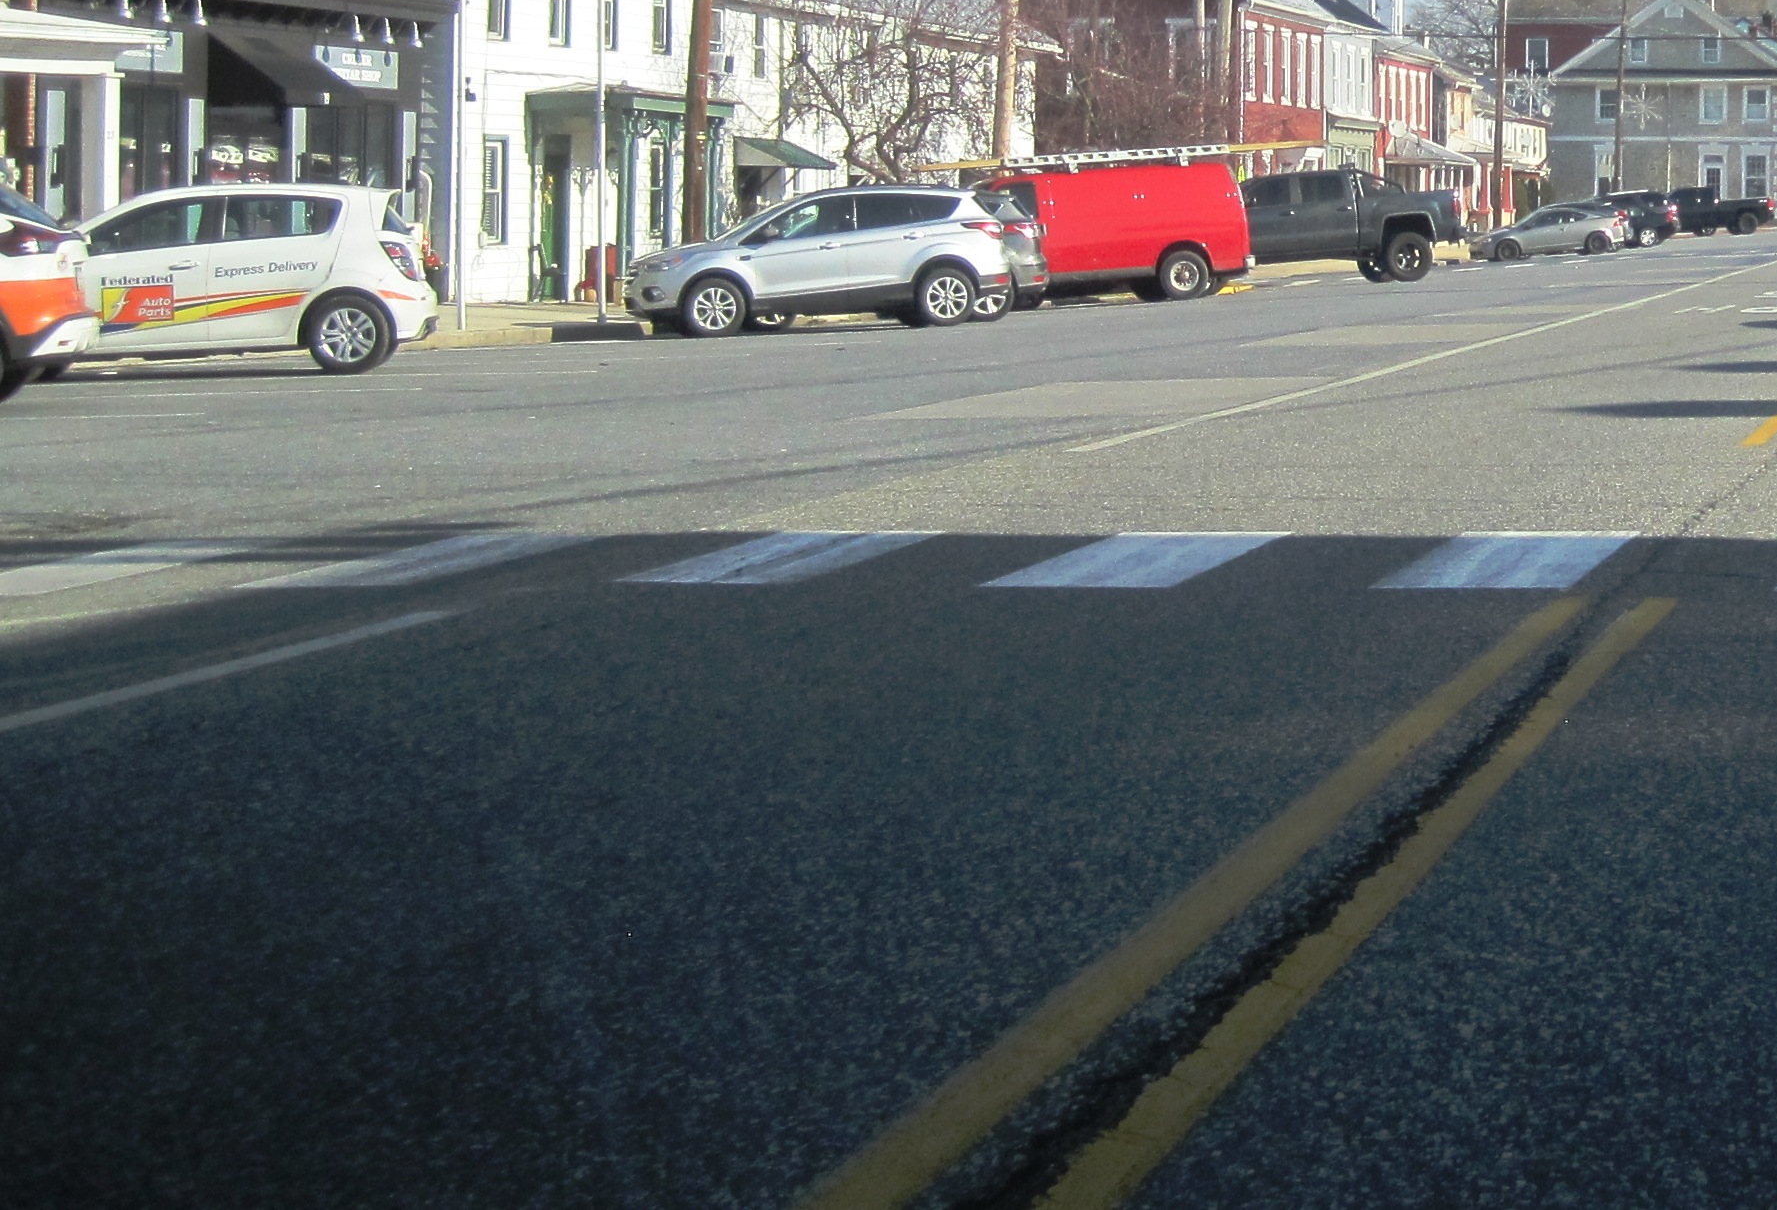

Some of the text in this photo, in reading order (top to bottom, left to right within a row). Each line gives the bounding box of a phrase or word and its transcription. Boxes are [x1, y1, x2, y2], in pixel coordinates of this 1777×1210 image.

[214, 260, 318, 278] Express Delivery
[101, 274, 173, 286] Federated
[143, 297, 171, 306] Auto
[138, 307, 172, 317] Parts
